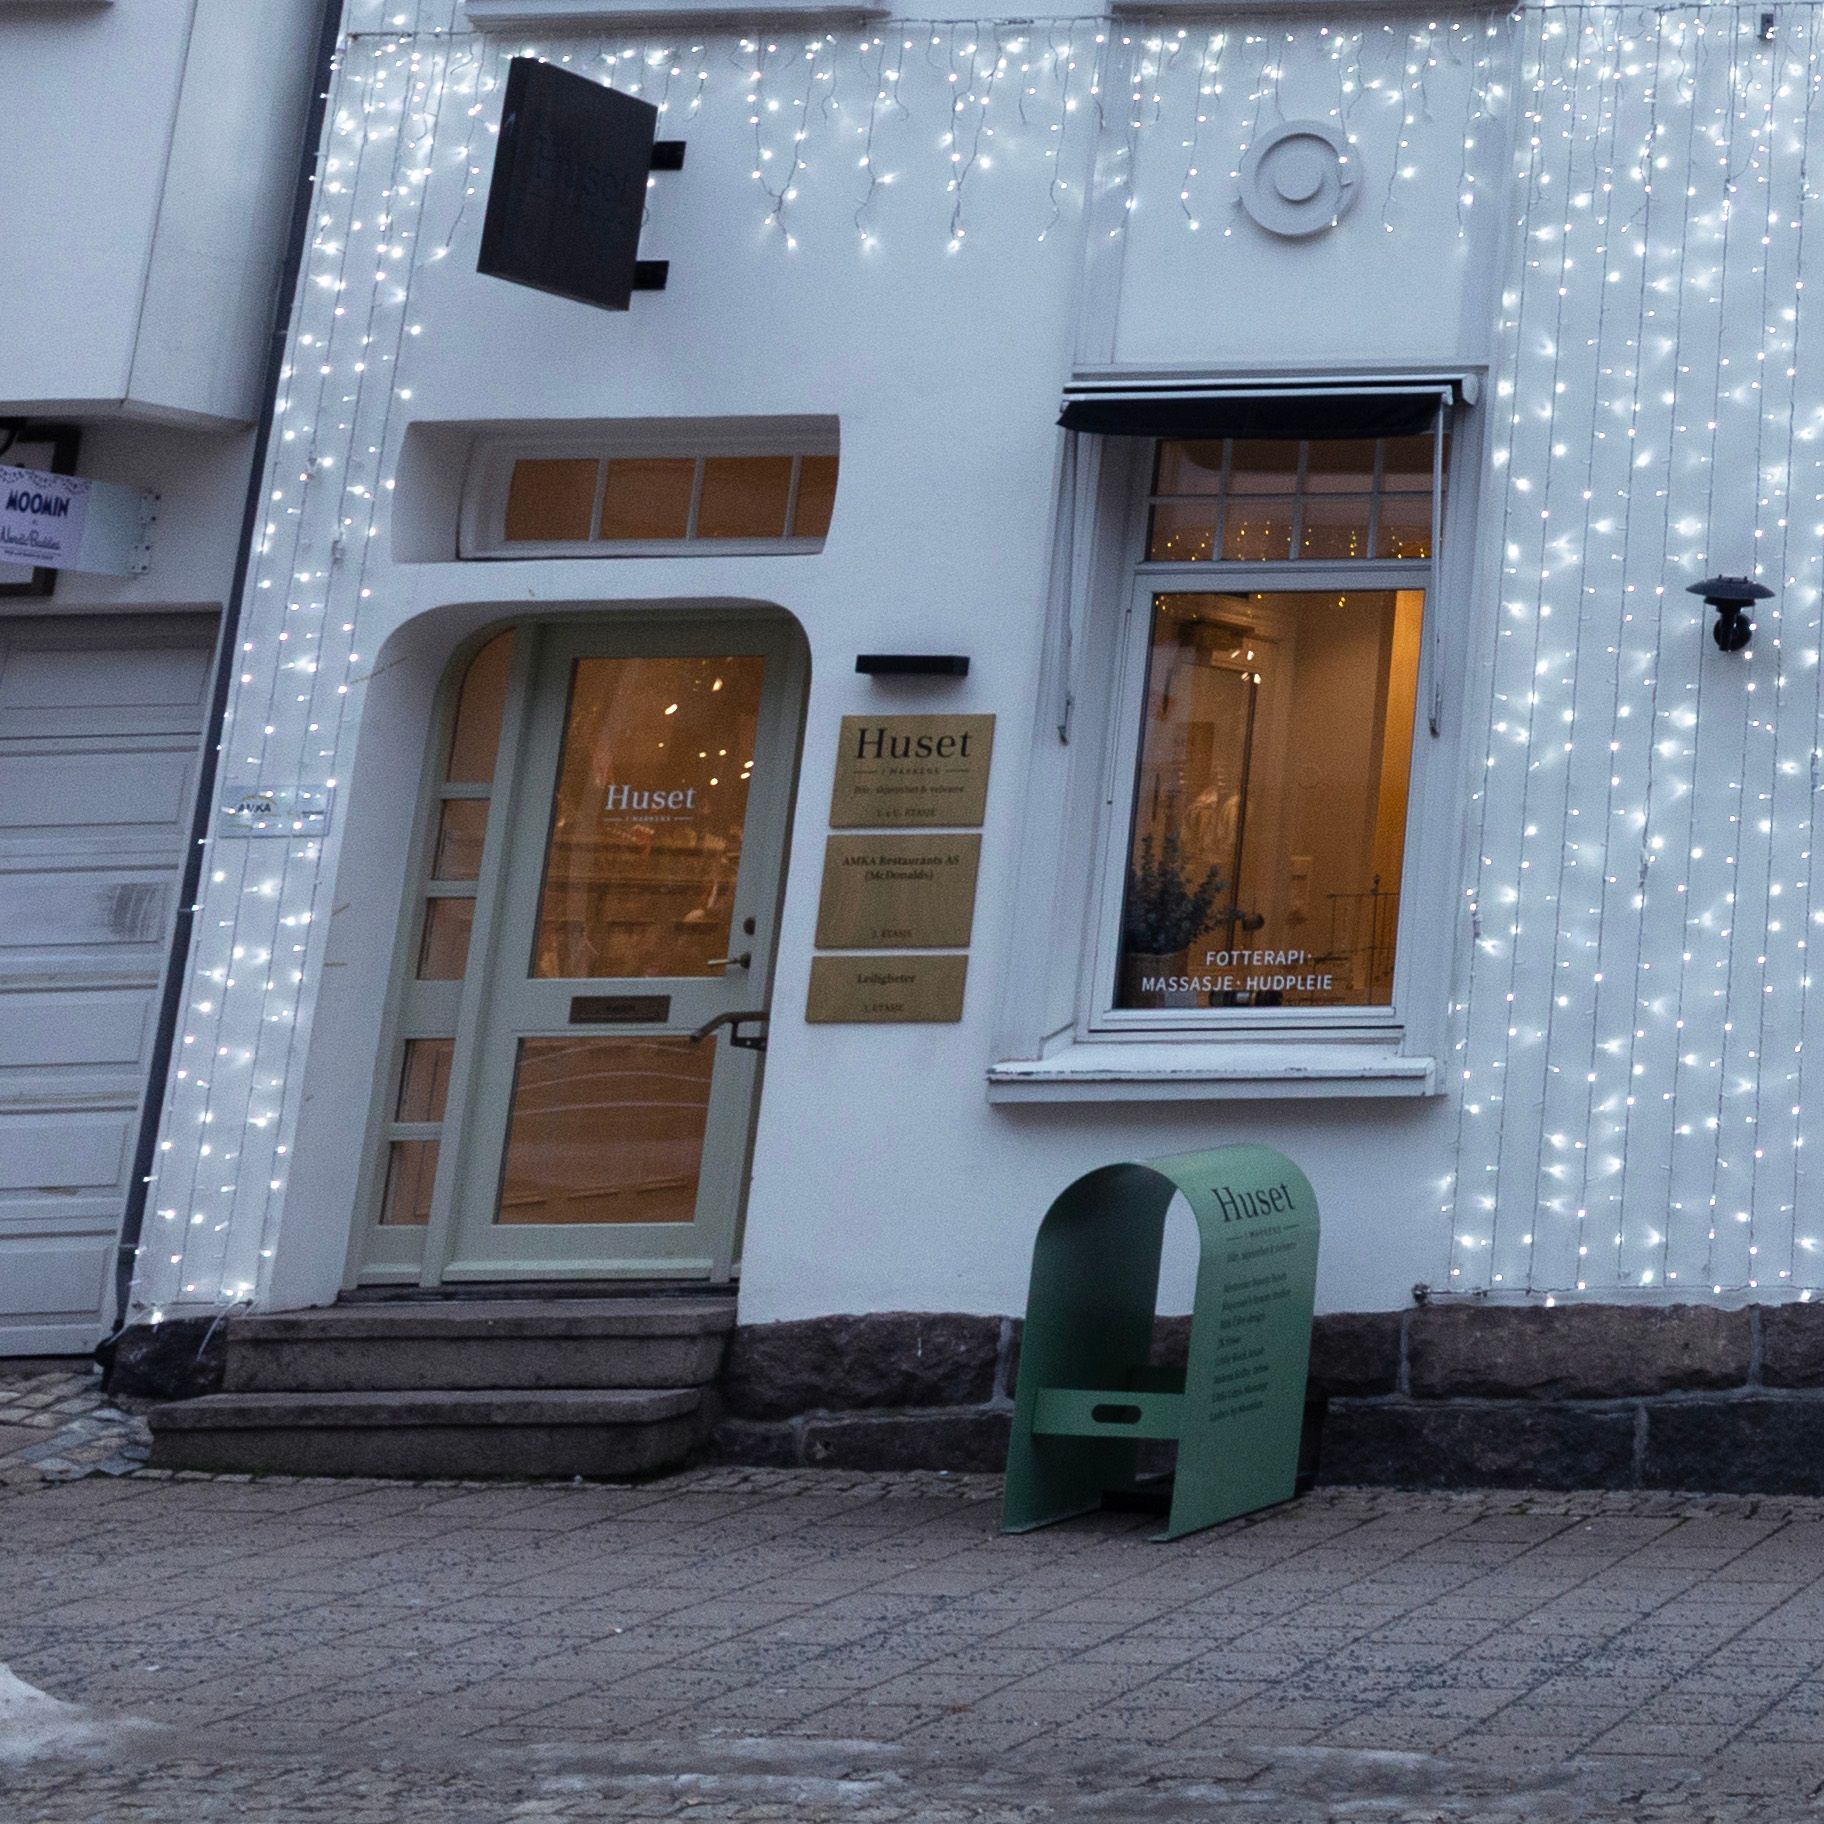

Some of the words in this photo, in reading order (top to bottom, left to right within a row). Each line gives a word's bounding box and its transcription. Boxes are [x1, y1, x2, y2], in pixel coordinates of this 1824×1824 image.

[5, 489, 71, 517] MOOMIN
[855, 727, 973, 759] Huset
[604, 784, 697, 811] Huset
[842, 856, 877, 866] AMKA
[879, 855, 942, 866] Restaurants
[945, 855, 960, 866] AS
[1210, 1182, 1296, 1223] Huset
